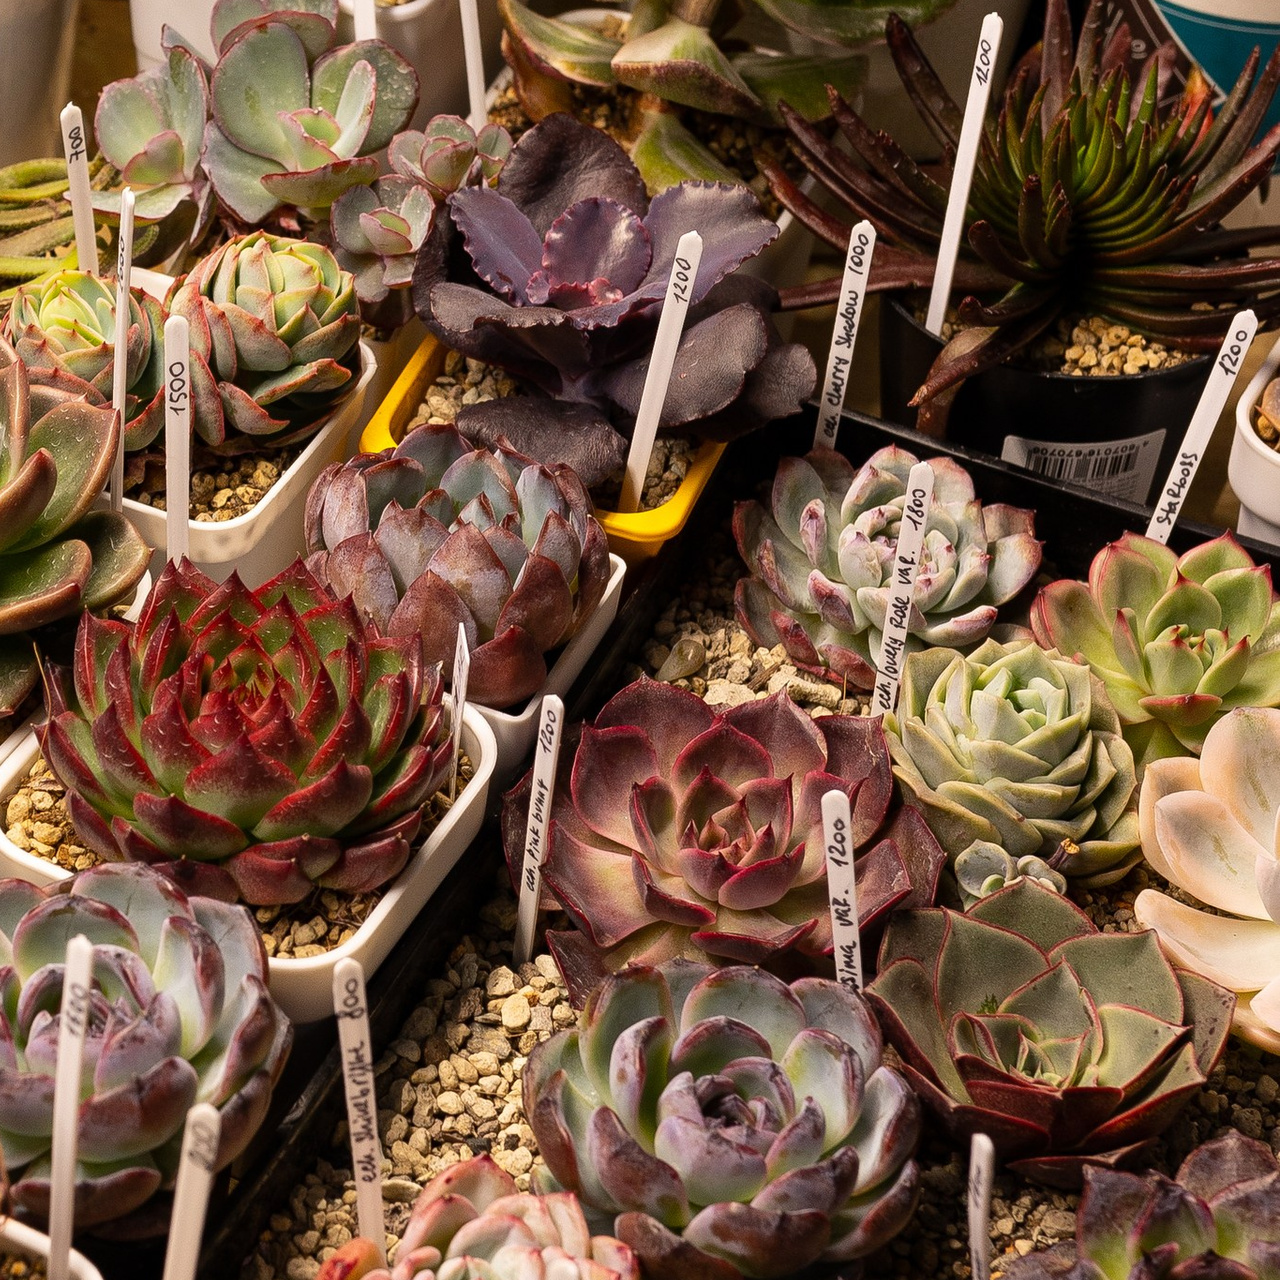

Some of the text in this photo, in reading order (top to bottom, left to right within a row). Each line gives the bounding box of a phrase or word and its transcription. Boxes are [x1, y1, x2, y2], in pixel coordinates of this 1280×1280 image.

[68, 125, 86, 164] 700
[848, 233, 869, 275] 1000
[673, 257, 691, 304] 1200
[1219, 330, 1248, 376] 1200
[168, 361, 188, 416] 1500
[890, 596, 911, 630] Rose
[906, 488, 927, 531] 1800
[539, 710, 557, 753] 1200
[828, 818, 849, 867] 1200
[336, 978, 364, 1019] 800
